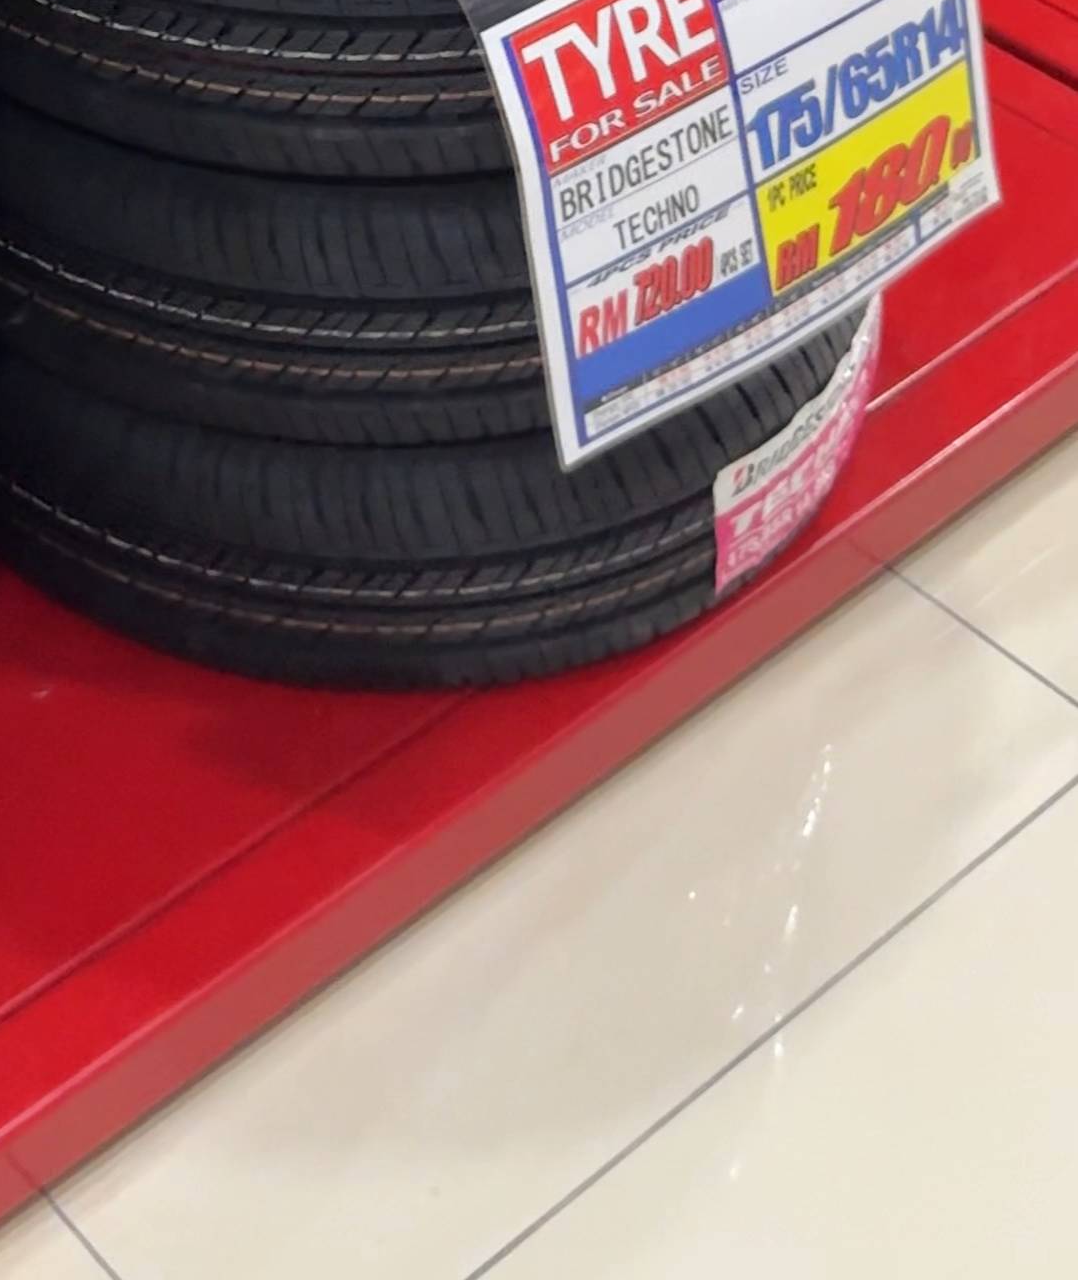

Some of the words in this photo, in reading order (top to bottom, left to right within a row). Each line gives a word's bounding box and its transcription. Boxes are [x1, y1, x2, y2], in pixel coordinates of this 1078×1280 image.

[549, 108, 626, 163] FOR
[632, 54, 723, 118] SALE
[741, 56, 789, 95] SIZE
[560, 104, 733, 222] BRIDGESTONE
[776, 223, 820, 291] RM
[828, 115, 951, 257] 180
[789, 163, 818, 196] PRICE
[612, 183, 701, 251] TECHNO
[658, 206, 733, 253] PRICE
[578, 288, 628, 359] RM
[633, 235, 714, 326] 720.00
